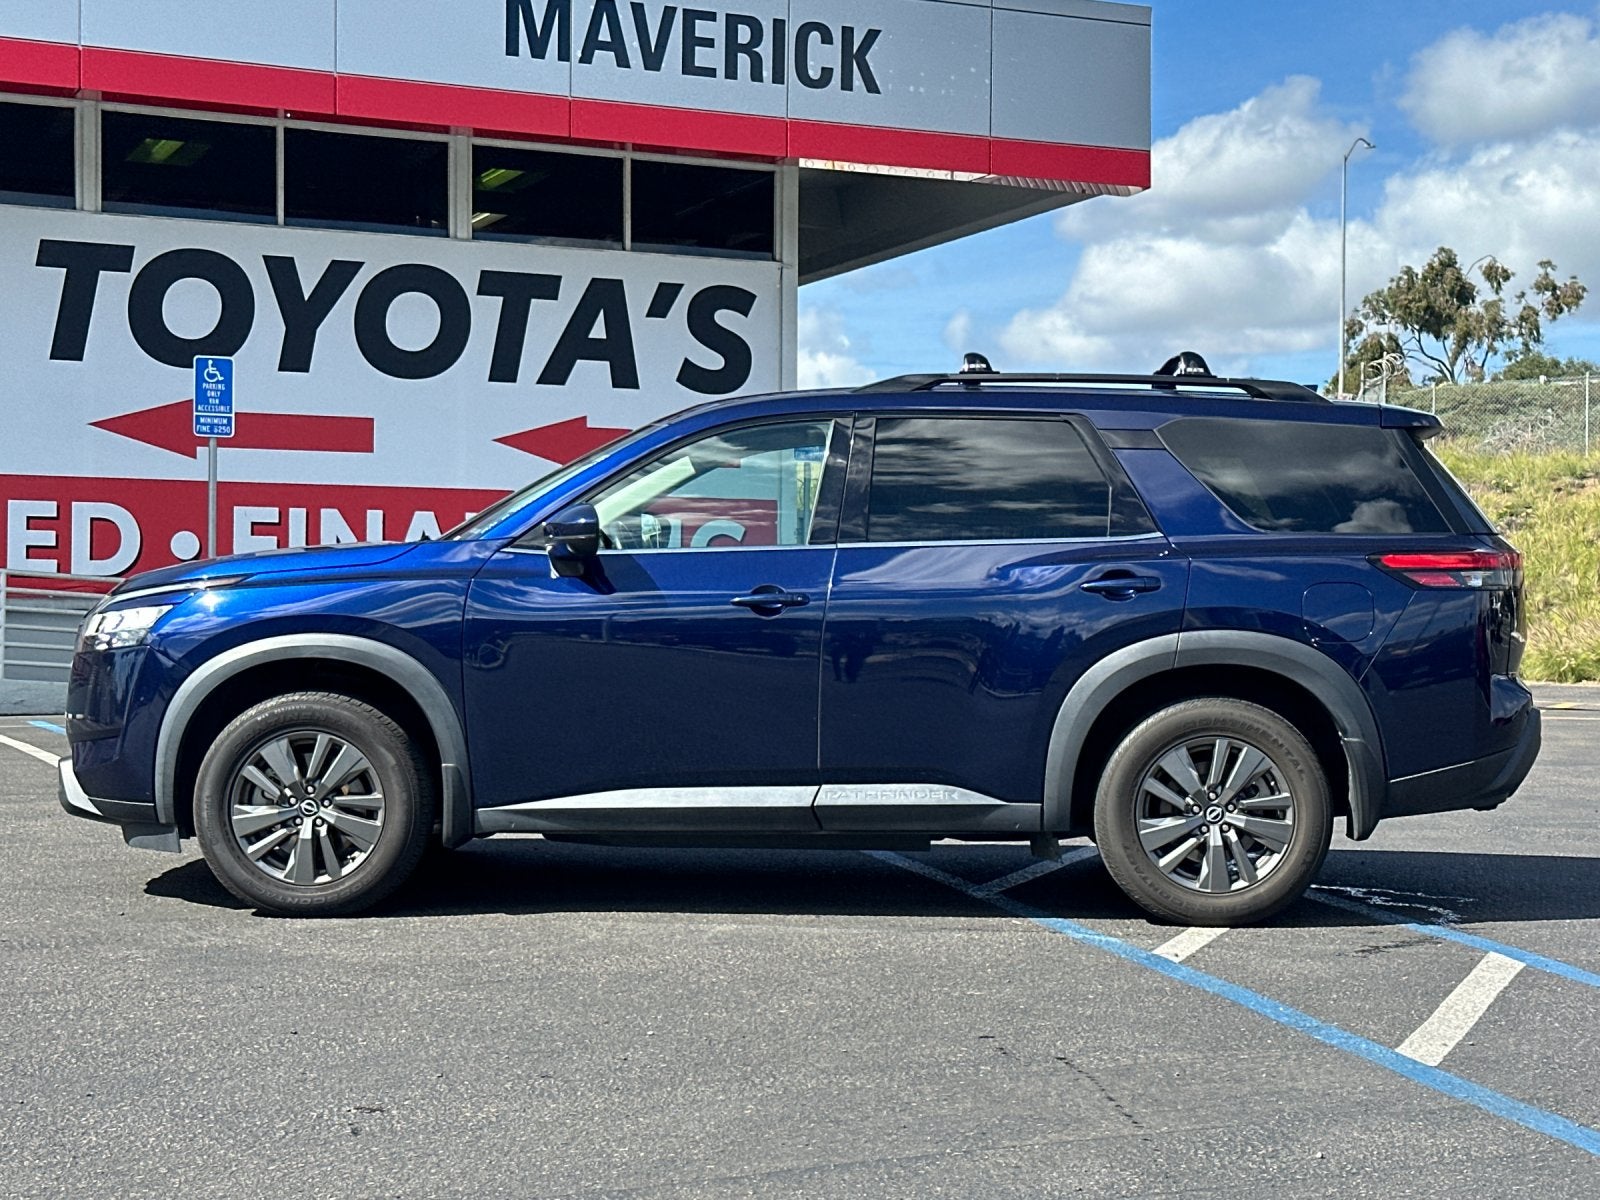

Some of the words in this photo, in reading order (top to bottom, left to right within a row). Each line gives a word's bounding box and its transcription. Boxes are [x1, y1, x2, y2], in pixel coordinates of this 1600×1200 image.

[505, 0, 882, 94] MAVERICK
[35, 239, 757, 395] TOYOTA'S
[202, 383, 225, 391] PARKING
[207, 390, 221, 398] ONLY
[198, 404, 231, 412] ACCESSIBLE
[200, 416, 228, 425] MINIMUM
[196, 425, 211, 433] FINE
[214, 425, 231, 433] $250
[824, 789, 959, 801] PATHFINDER
